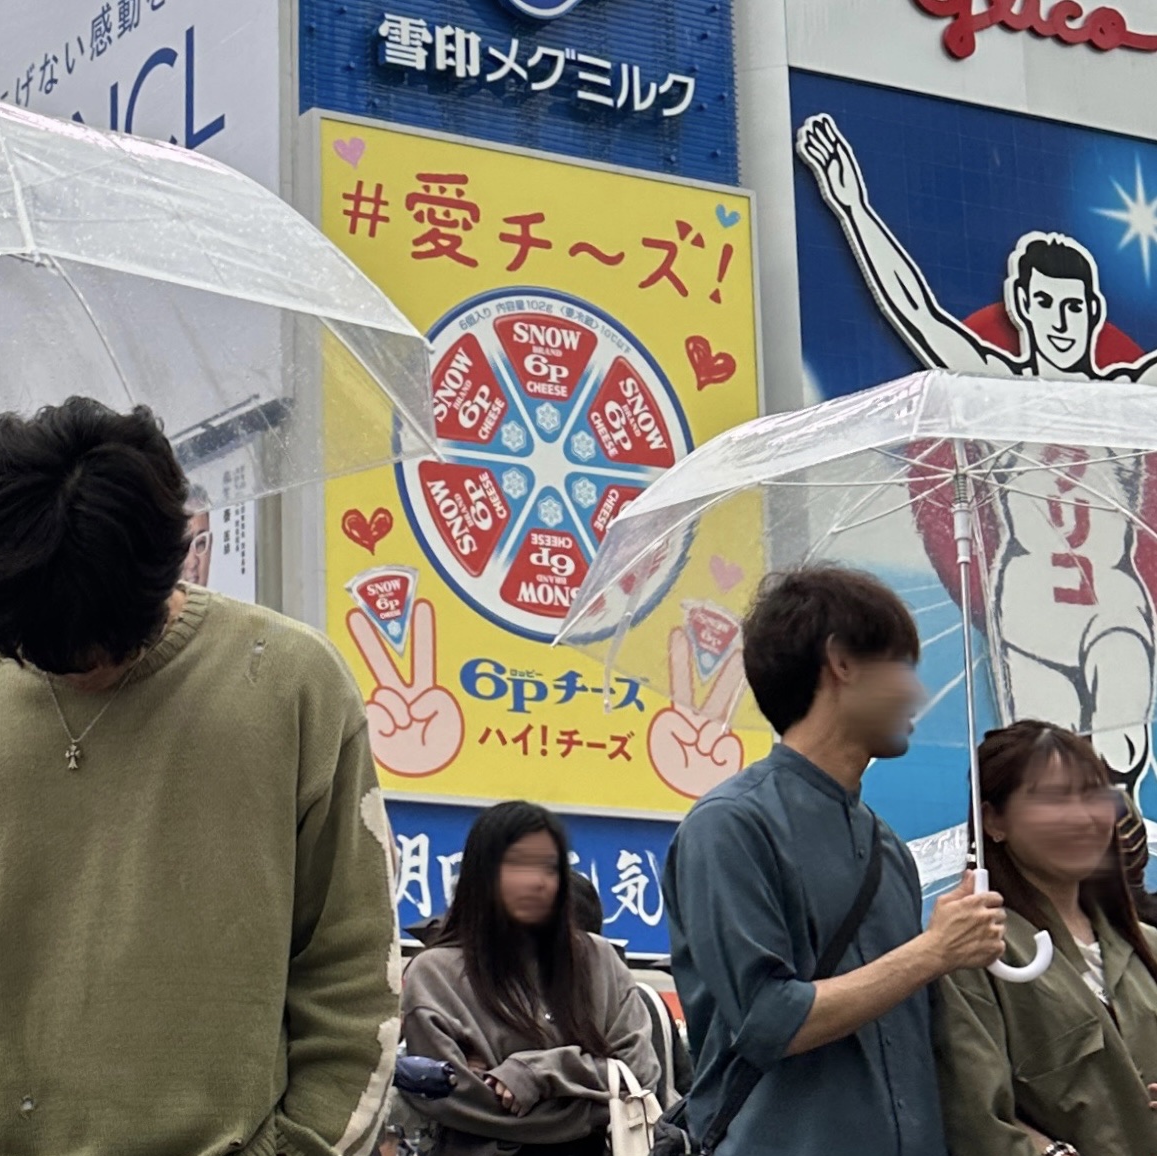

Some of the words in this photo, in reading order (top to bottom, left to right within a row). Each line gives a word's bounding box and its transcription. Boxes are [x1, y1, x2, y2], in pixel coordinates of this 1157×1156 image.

[378, 13, 696, 117] 雪印メグミルク
[513, 321, 582, 351] SNOW
[532, 346, 563, 358] BRAND
[433, 347, 474, 423] SNOW
[523, 353, 569, 383] 6P
[526, 380, 568, 398] CHEESE
[457, 384, 492, 429] 6P
[478, 397, 506, 440] CHEESE
[604, 400, 634, 451] 6P
[619, 376, 668, 451] SNOW
[590, 411, 620, 458] CHEESE
[426, 479, 478, 556] SNOW
[463, 478, 493, 532] 6P
[478, 471, 508, 520] CHEESE
[593, 488, 620, 532] CHEESE
[529, 547, 576, 577] 6P
[530, 533, 573, 549] CHEESE
[367, 579, 401, 597] SNOW
[478, 723, 635, 762] ハイ!チーズ
